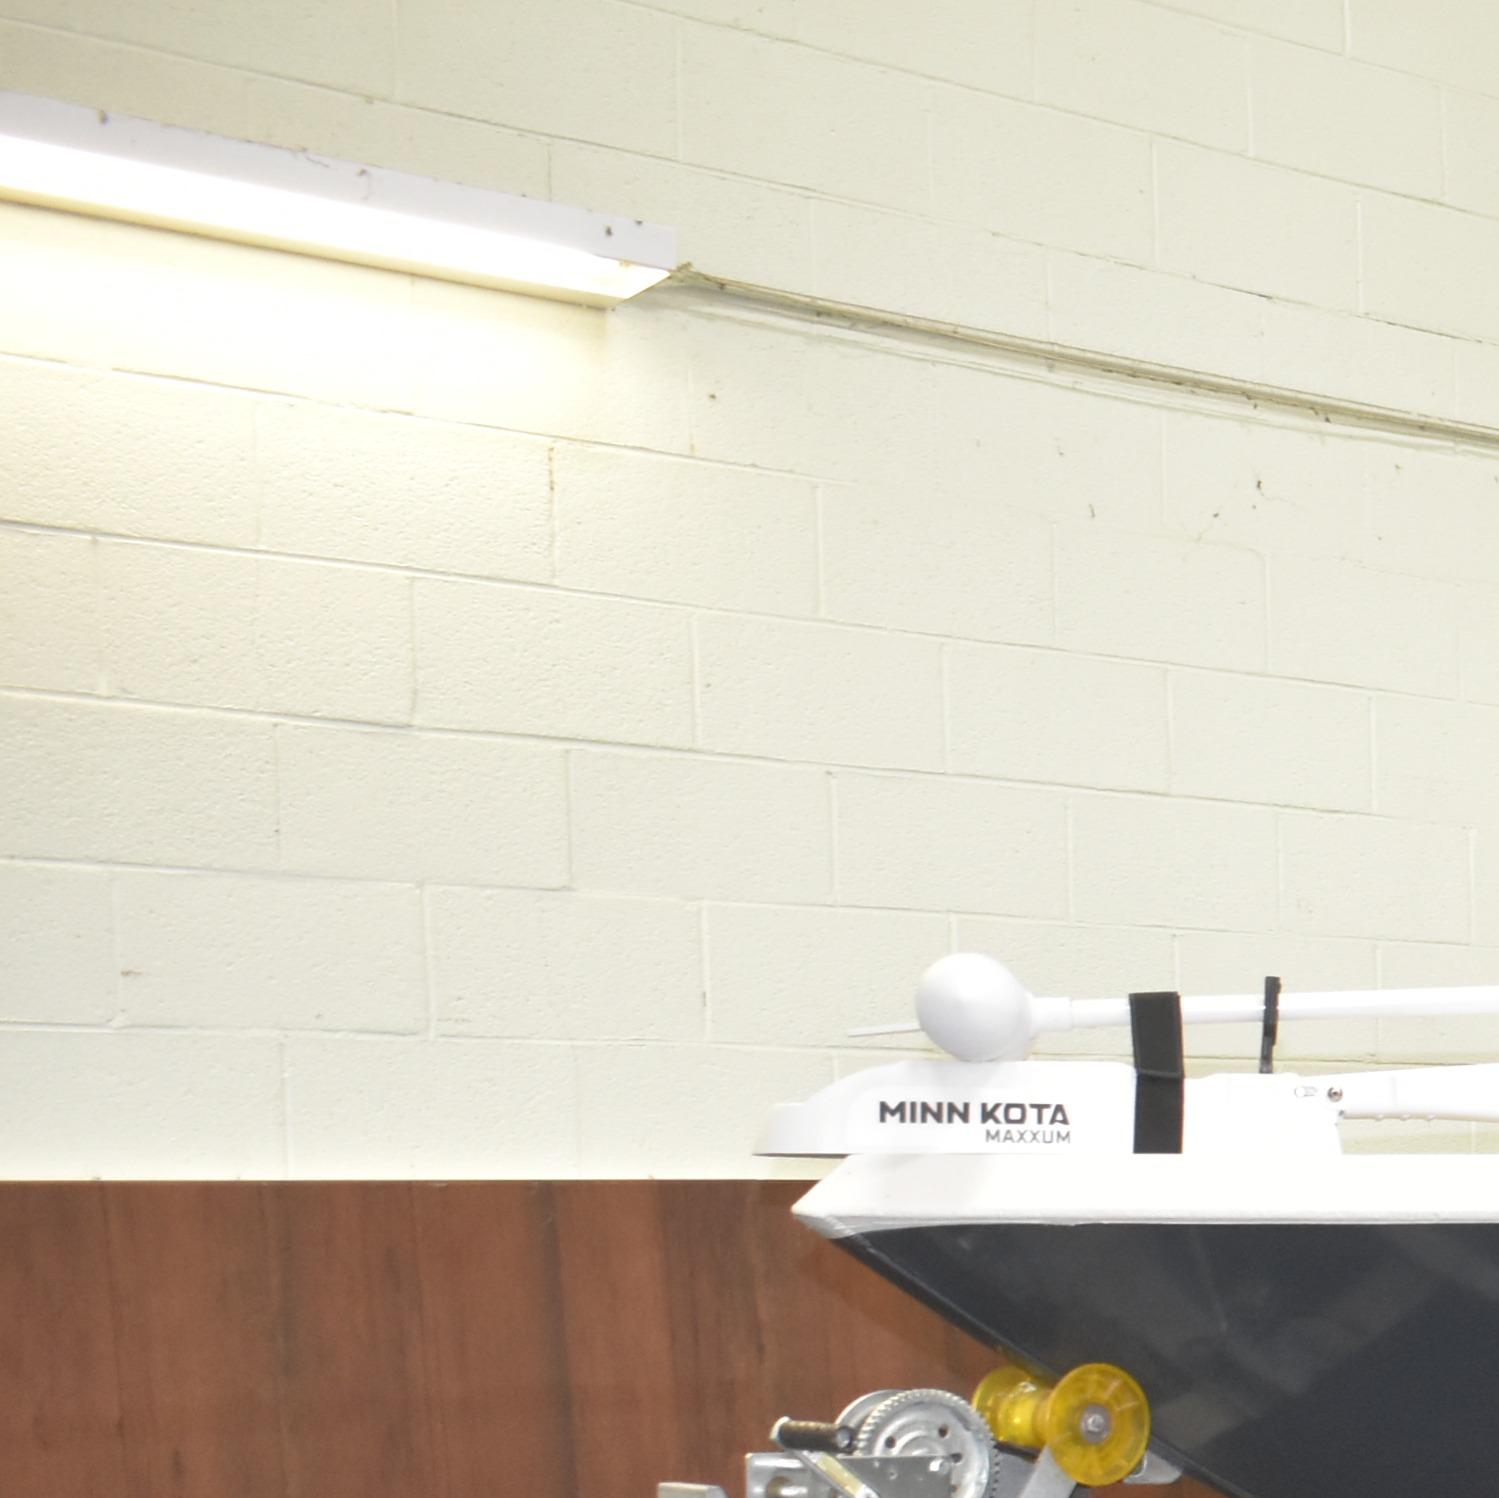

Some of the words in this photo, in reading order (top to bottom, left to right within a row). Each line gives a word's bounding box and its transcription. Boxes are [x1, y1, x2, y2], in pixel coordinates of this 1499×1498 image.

[879, 1100, 970, 1124] MINN
[980, 1102, 1071, 1126] KOTA
[985, 1128, 1072, 1145] MAXXUM
